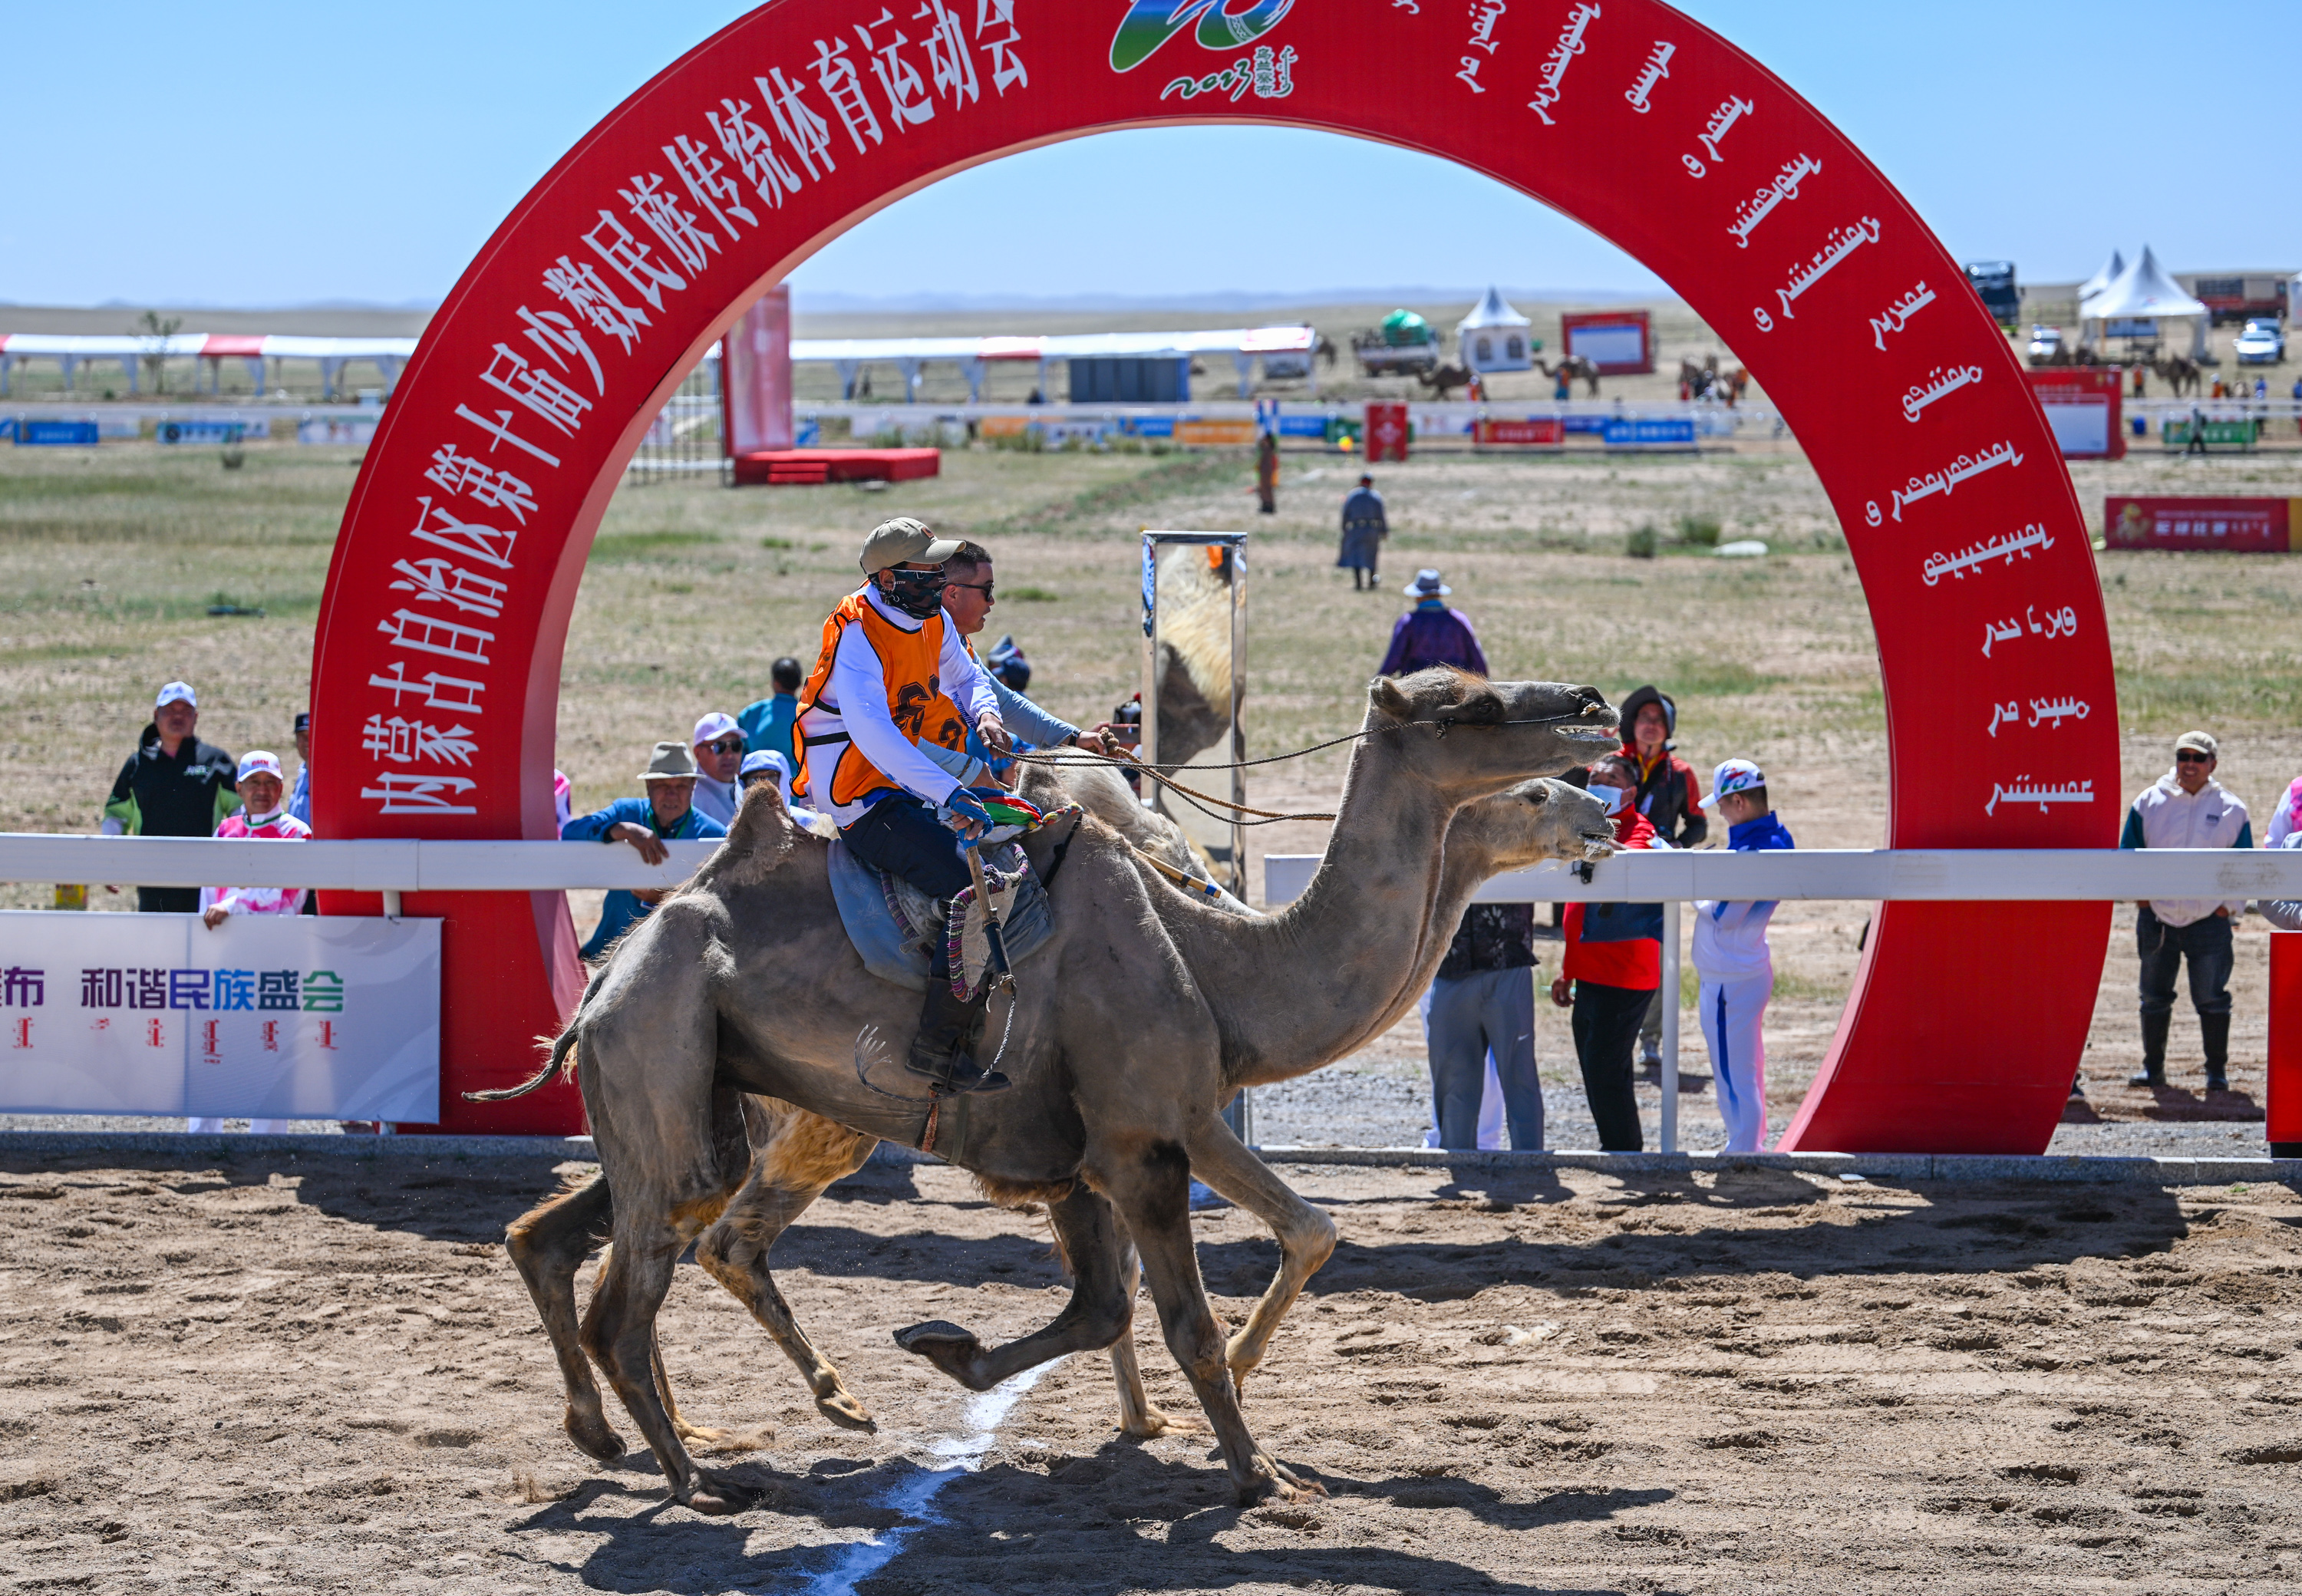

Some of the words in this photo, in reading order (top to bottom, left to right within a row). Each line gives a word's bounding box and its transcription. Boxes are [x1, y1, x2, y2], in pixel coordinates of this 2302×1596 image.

[361, 0, 1027, 815] 内蒙古自治区第十届少数民族传统体育运动会
[0, 966, 45, 1007] 布
[81, 968, 344, 1011] 和谐民族盛会
